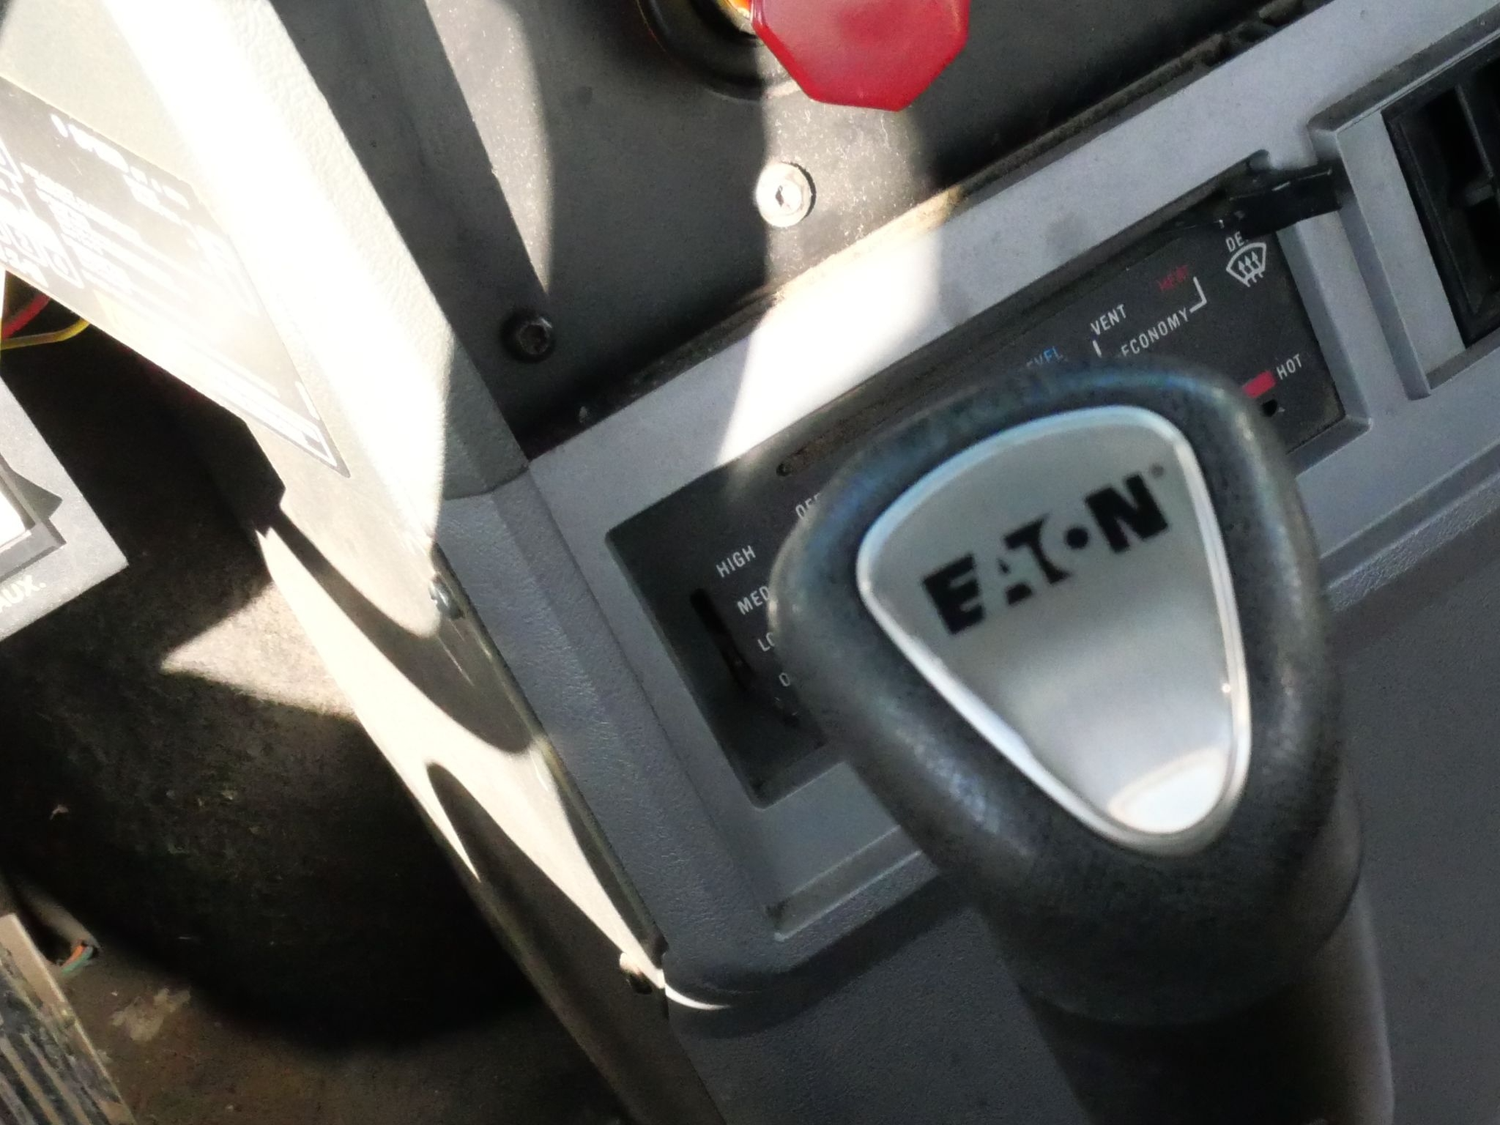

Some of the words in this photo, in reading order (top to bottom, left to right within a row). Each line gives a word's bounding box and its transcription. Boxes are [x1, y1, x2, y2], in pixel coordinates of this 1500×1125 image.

[1225, 231, 1249, 252] DE
[1090, 304, 1127, 335] VENT
[1121, 307, 1188, 357] ECONOMY
[1276, 354, 1303, 380] HOT
[716, 545, 756, 577] HIGH
[922, 472, 1168, 635] EATON
[737, 585, 770, 615] MED
